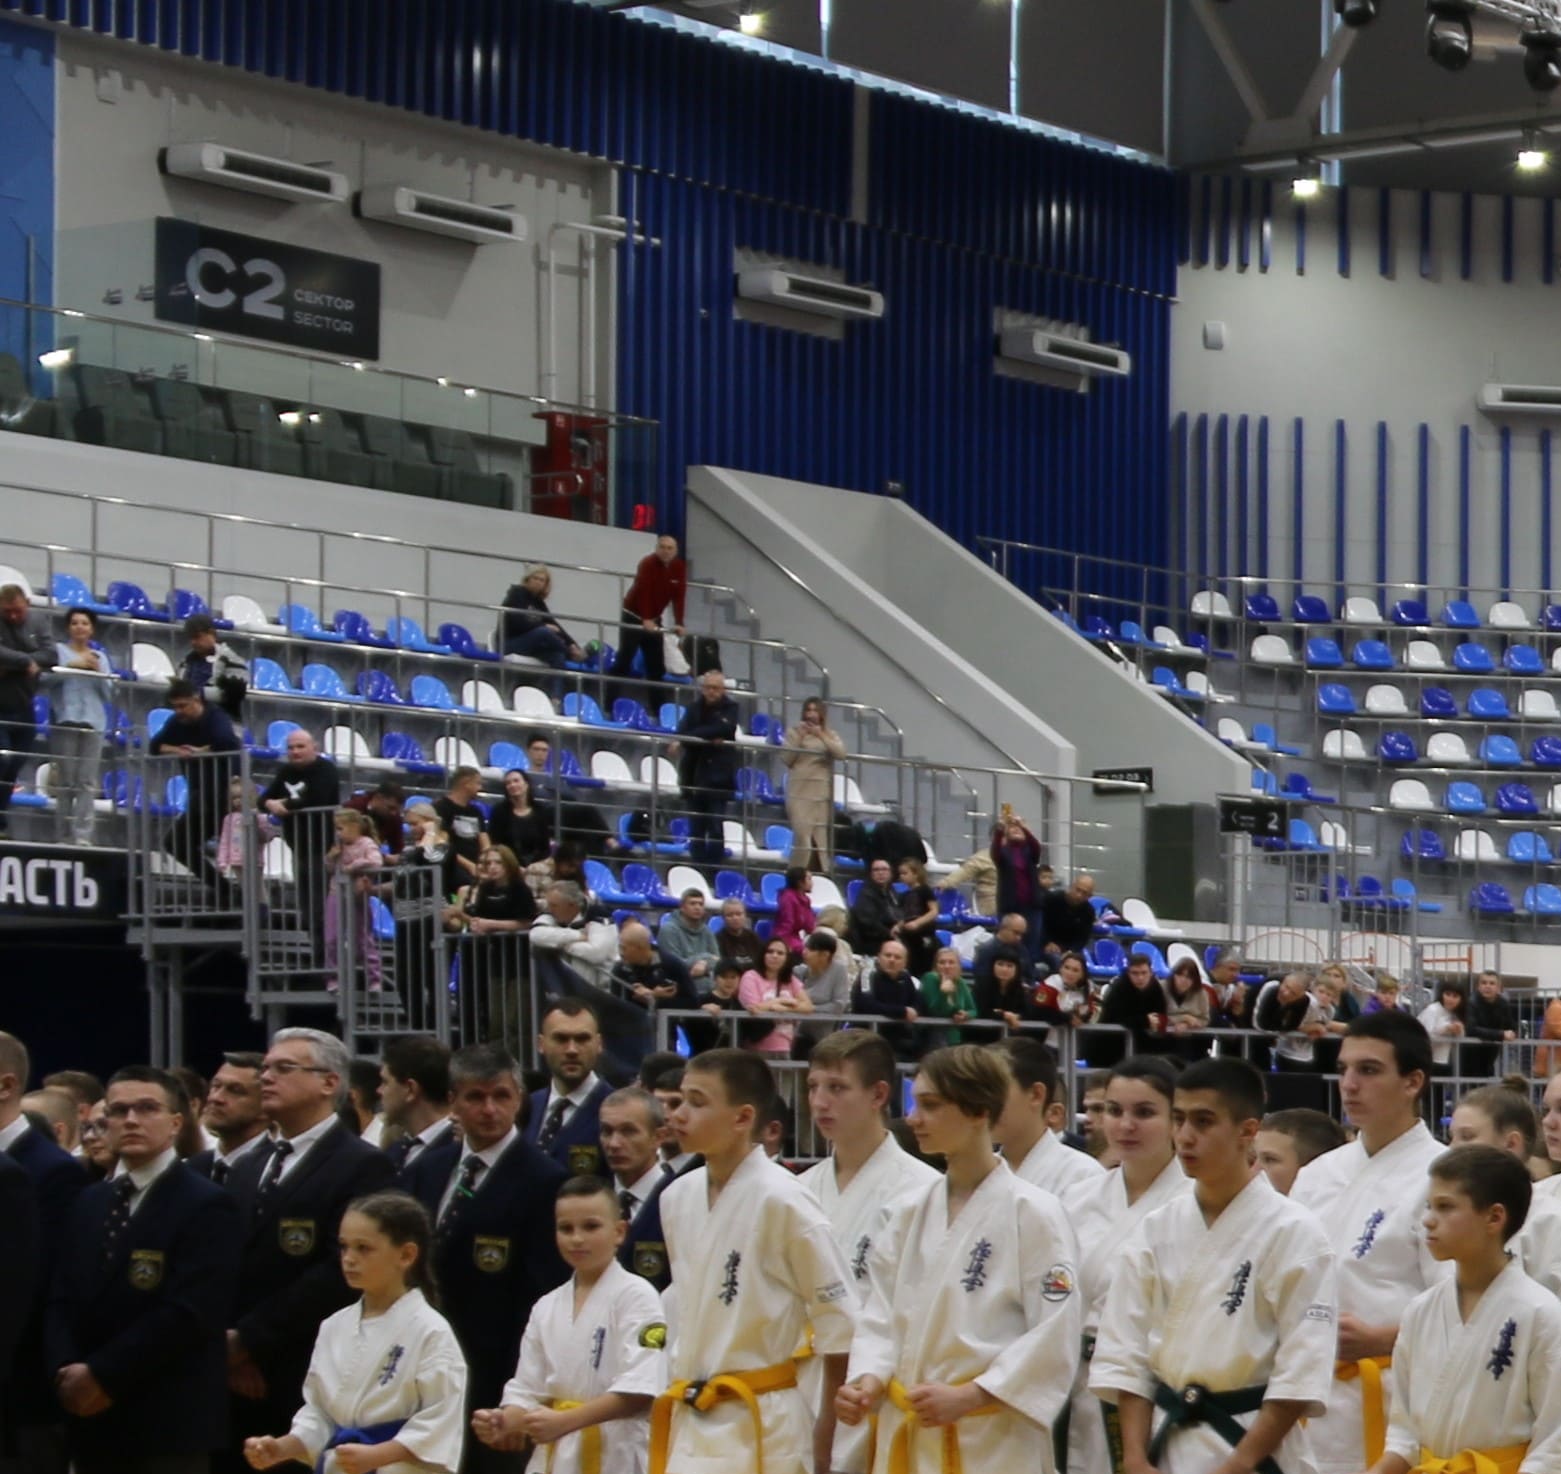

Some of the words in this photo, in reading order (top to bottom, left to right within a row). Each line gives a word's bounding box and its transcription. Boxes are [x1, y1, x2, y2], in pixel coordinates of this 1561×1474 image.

[186, 247, 287, 320] C2
[293, 289, 355, 311] СЕКТОР
[294, 311, 354, 334] SECTOR
[1267, 811, 1279, 830] 2
